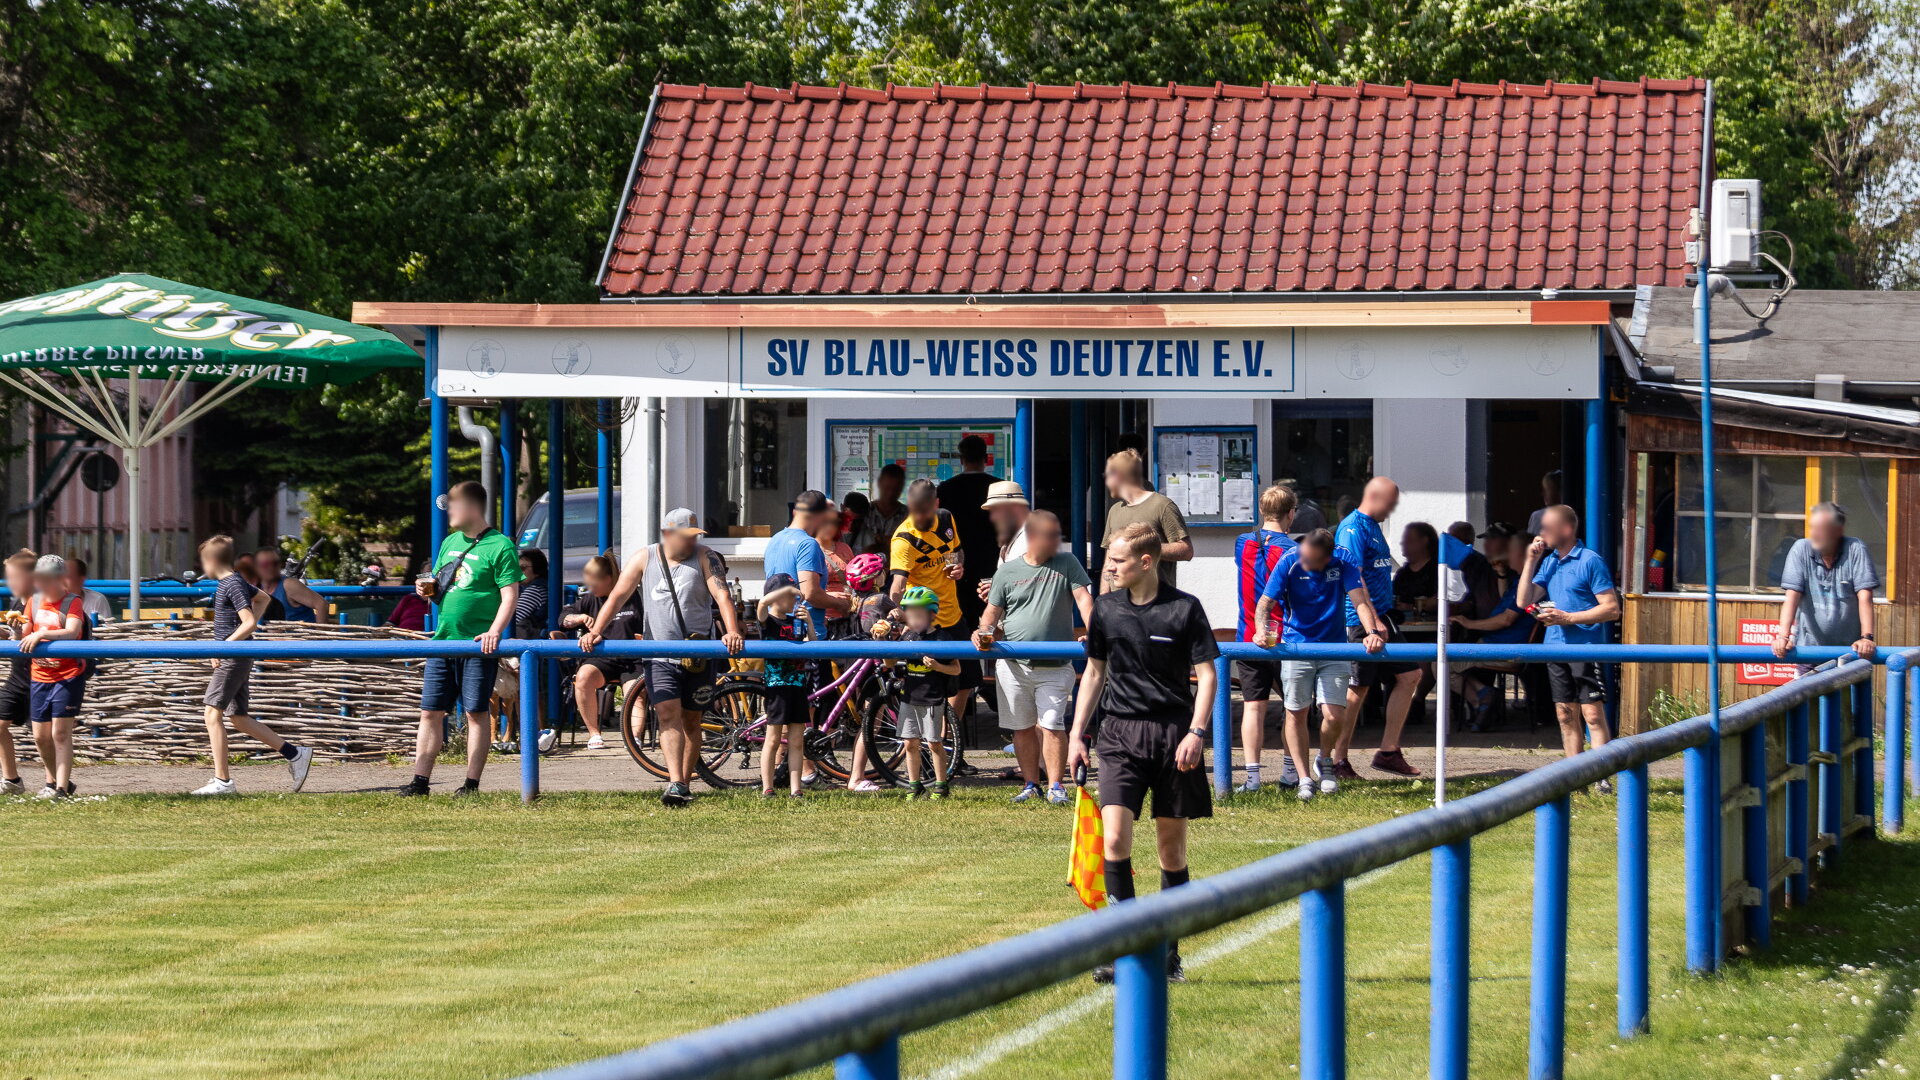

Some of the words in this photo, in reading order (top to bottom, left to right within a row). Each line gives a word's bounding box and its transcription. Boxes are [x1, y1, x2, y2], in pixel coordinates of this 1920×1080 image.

[767, 339, 809, 377] SV
[824, 339, 1038, 377] BLAU-WEISS
[1050, 339, 1200, 377] DEUTZEN
[1213, 339, 1273, 377] E.V.
[1742, 623, 1767, 633] DEIN
[1742, 634, 1774, 644] RUND
